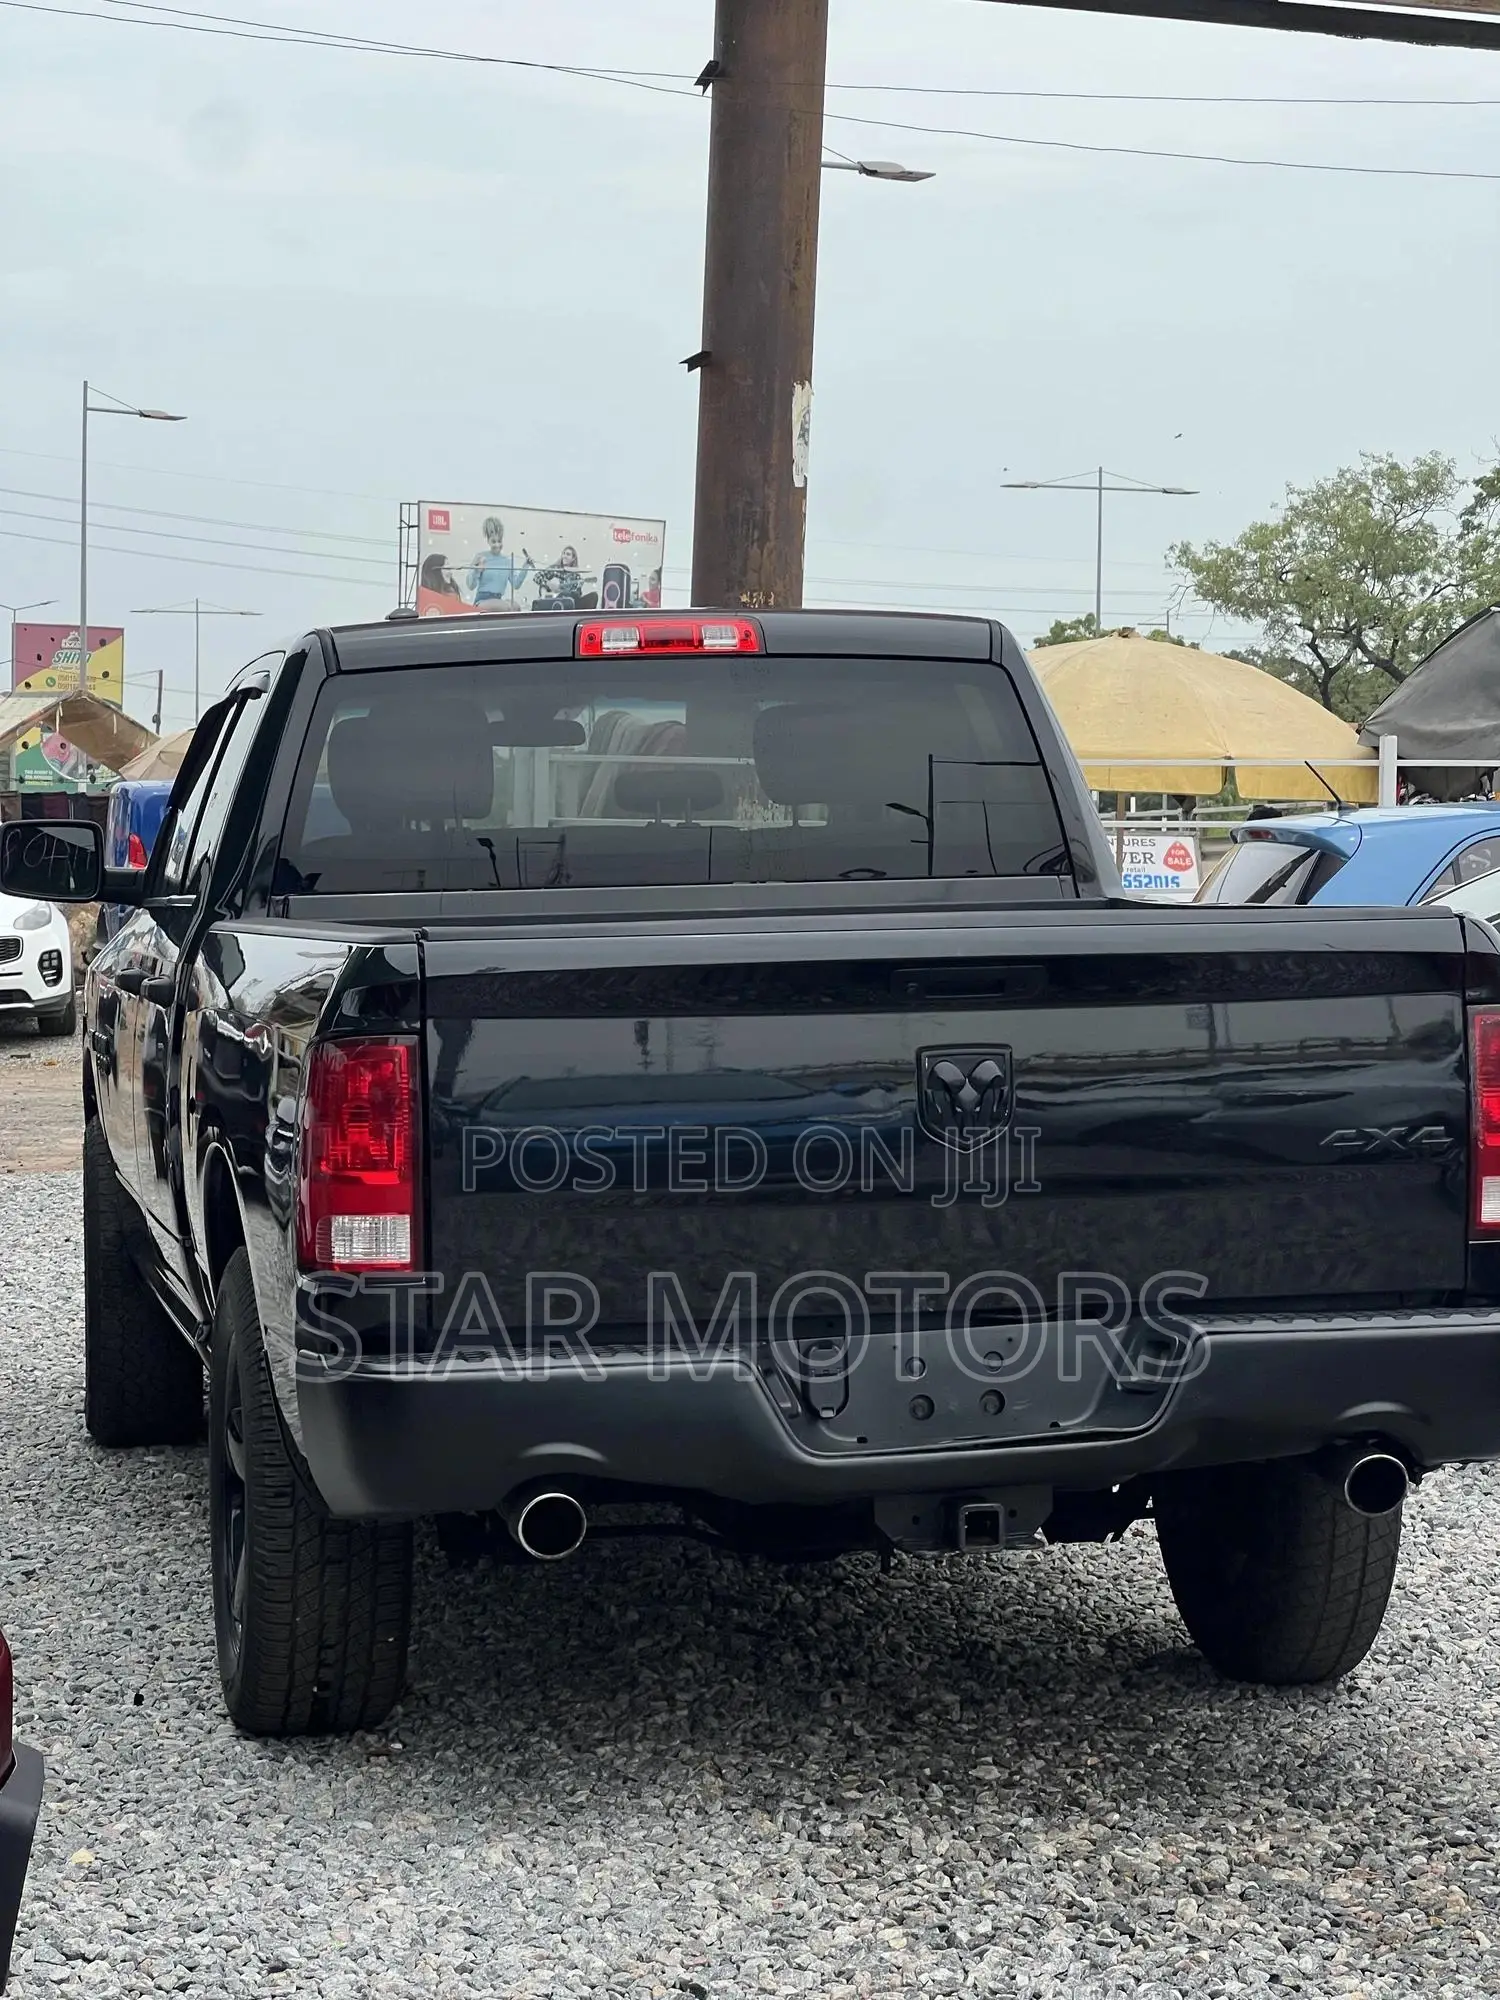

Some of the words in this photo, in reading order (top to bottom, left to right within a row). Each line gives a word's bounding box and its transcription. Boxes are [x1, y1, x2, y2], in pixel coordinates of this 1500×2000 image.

[432, 515, 447, 525] JBL
[614, 529, 658, 543] telefonika
[1109, 838, 1156, 847] NURES
[1167, 857, 1192, 865] SALE
